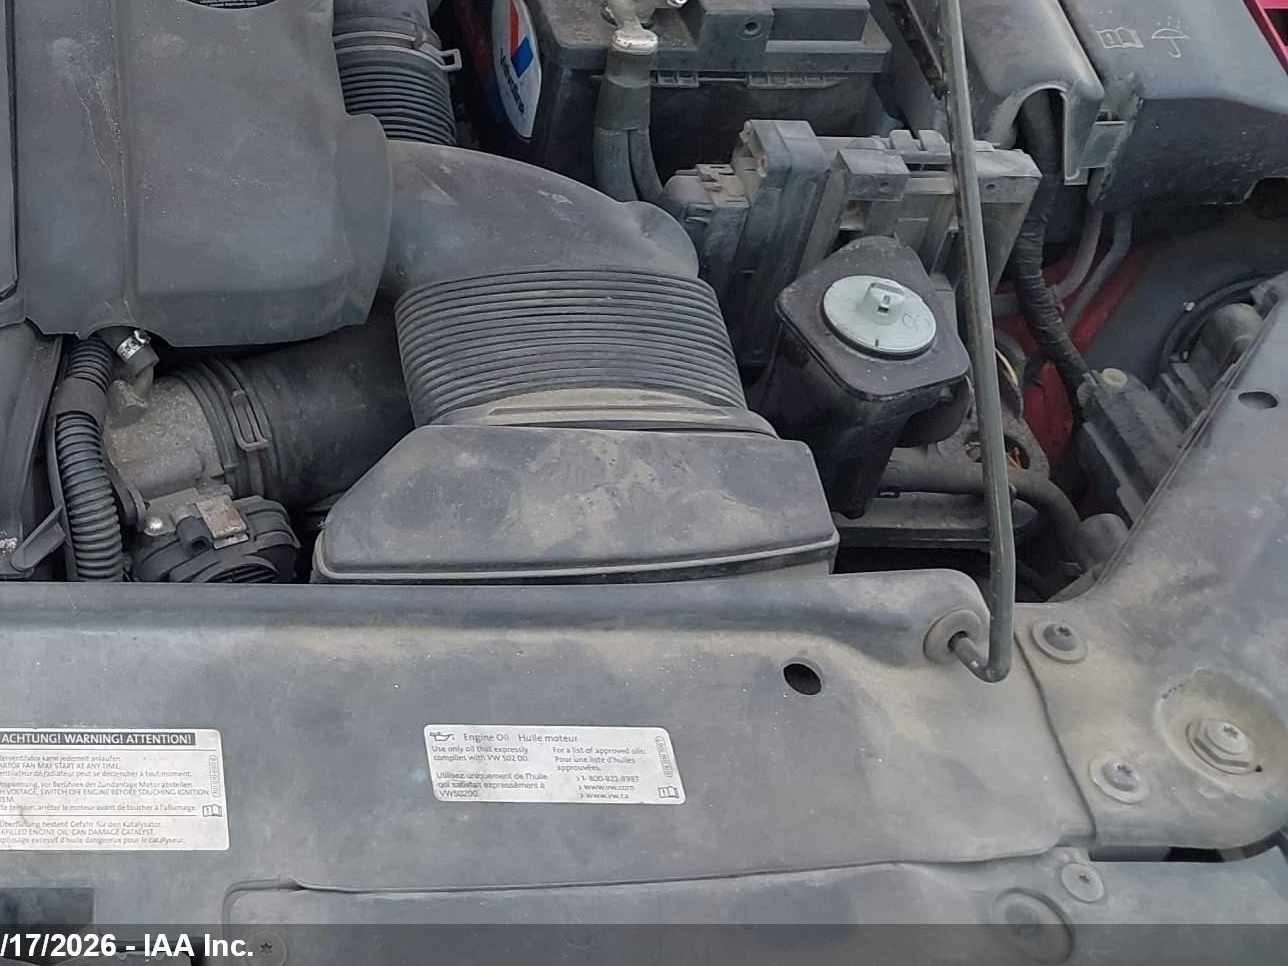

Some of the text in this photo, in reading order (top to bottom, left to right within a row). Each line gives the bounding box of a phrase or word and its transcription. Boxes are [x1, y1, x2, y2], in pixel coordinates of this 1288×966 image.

[1, 733, 192, 744] ACHTUNG! WARNING! ATTENTION!
[464, 733, 578, 742] Engine Oil Huile moteur
